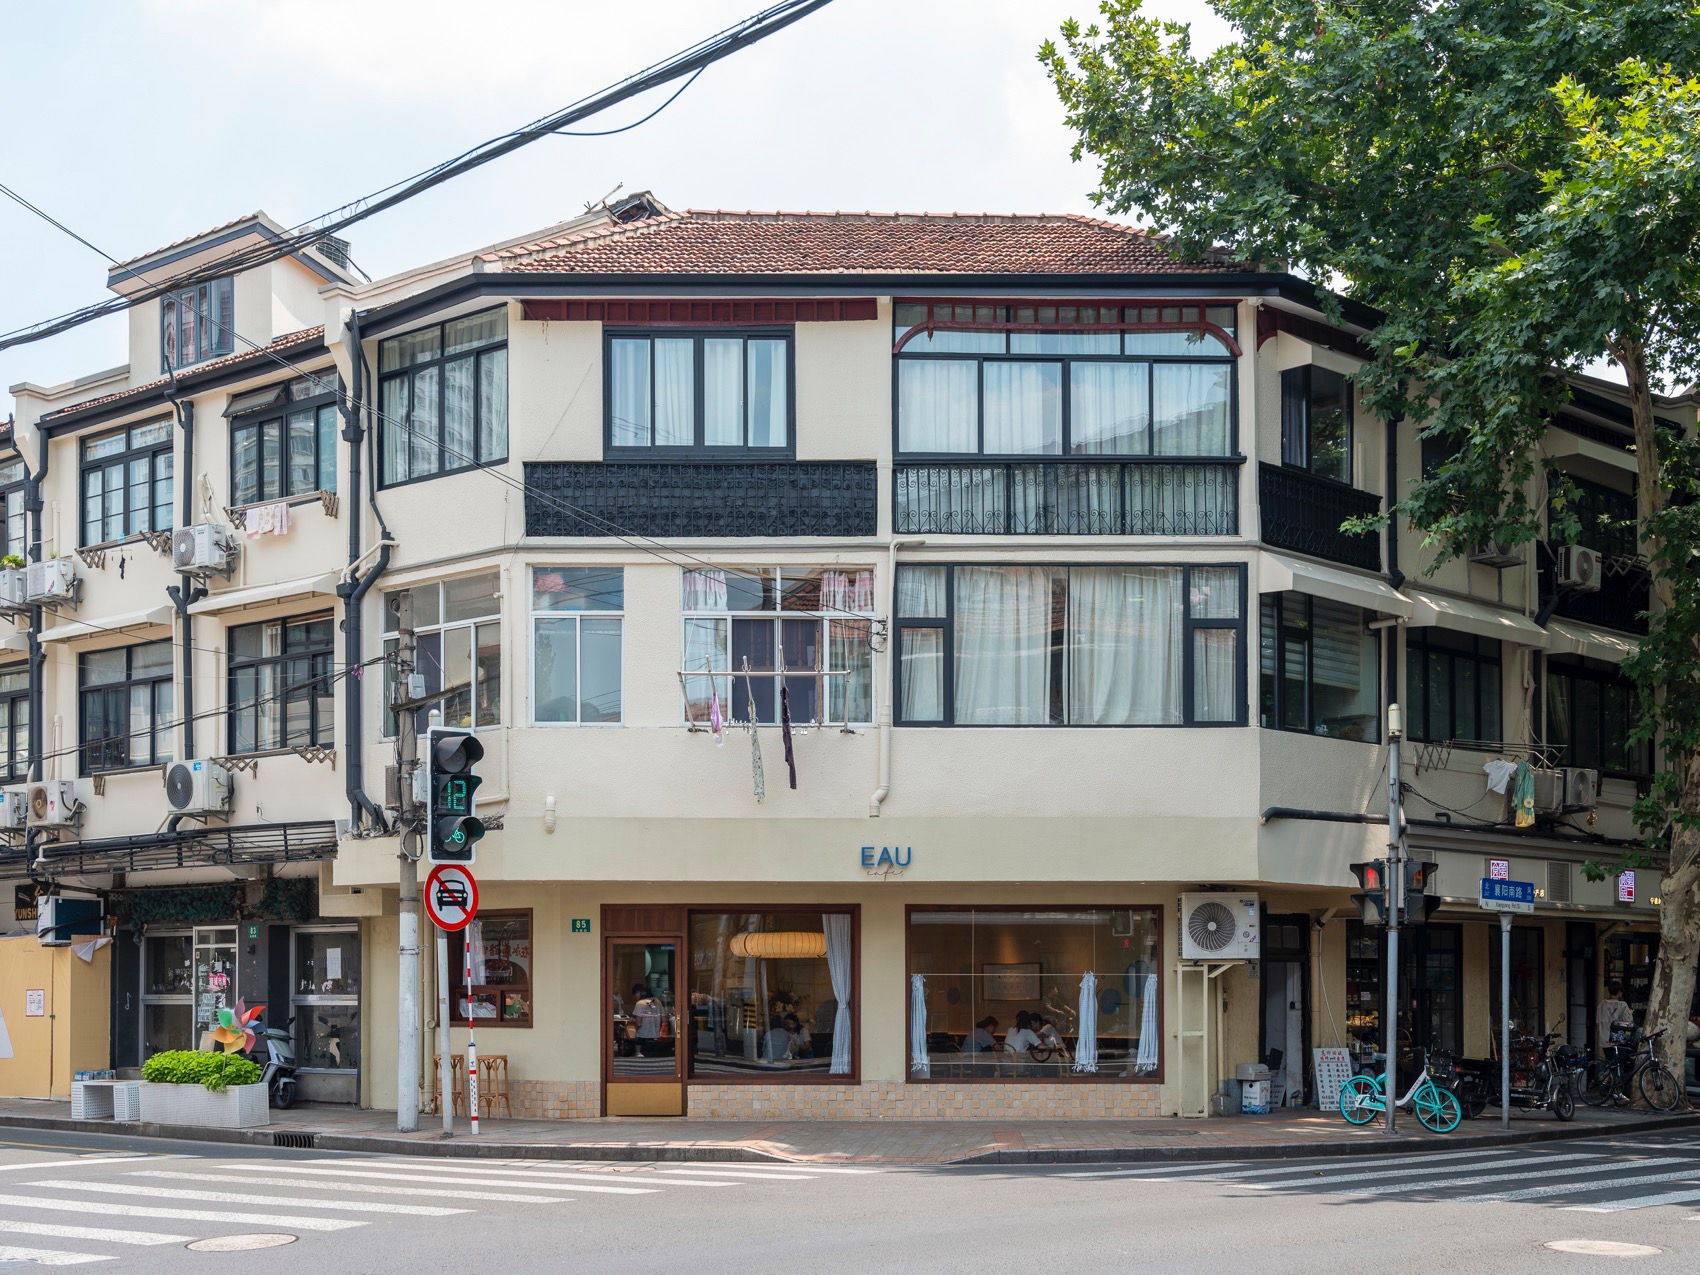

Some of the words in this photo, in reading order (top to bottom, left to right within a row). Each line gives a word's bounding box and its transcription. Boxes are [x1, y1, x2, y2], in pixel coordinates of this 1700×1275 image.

[447, 780, 467, 810] 12
[861, 846, 911, 867] EAU
[1494, 883, 1523, 899] 襄阳南路
[575, 920, 587, 929] 85
